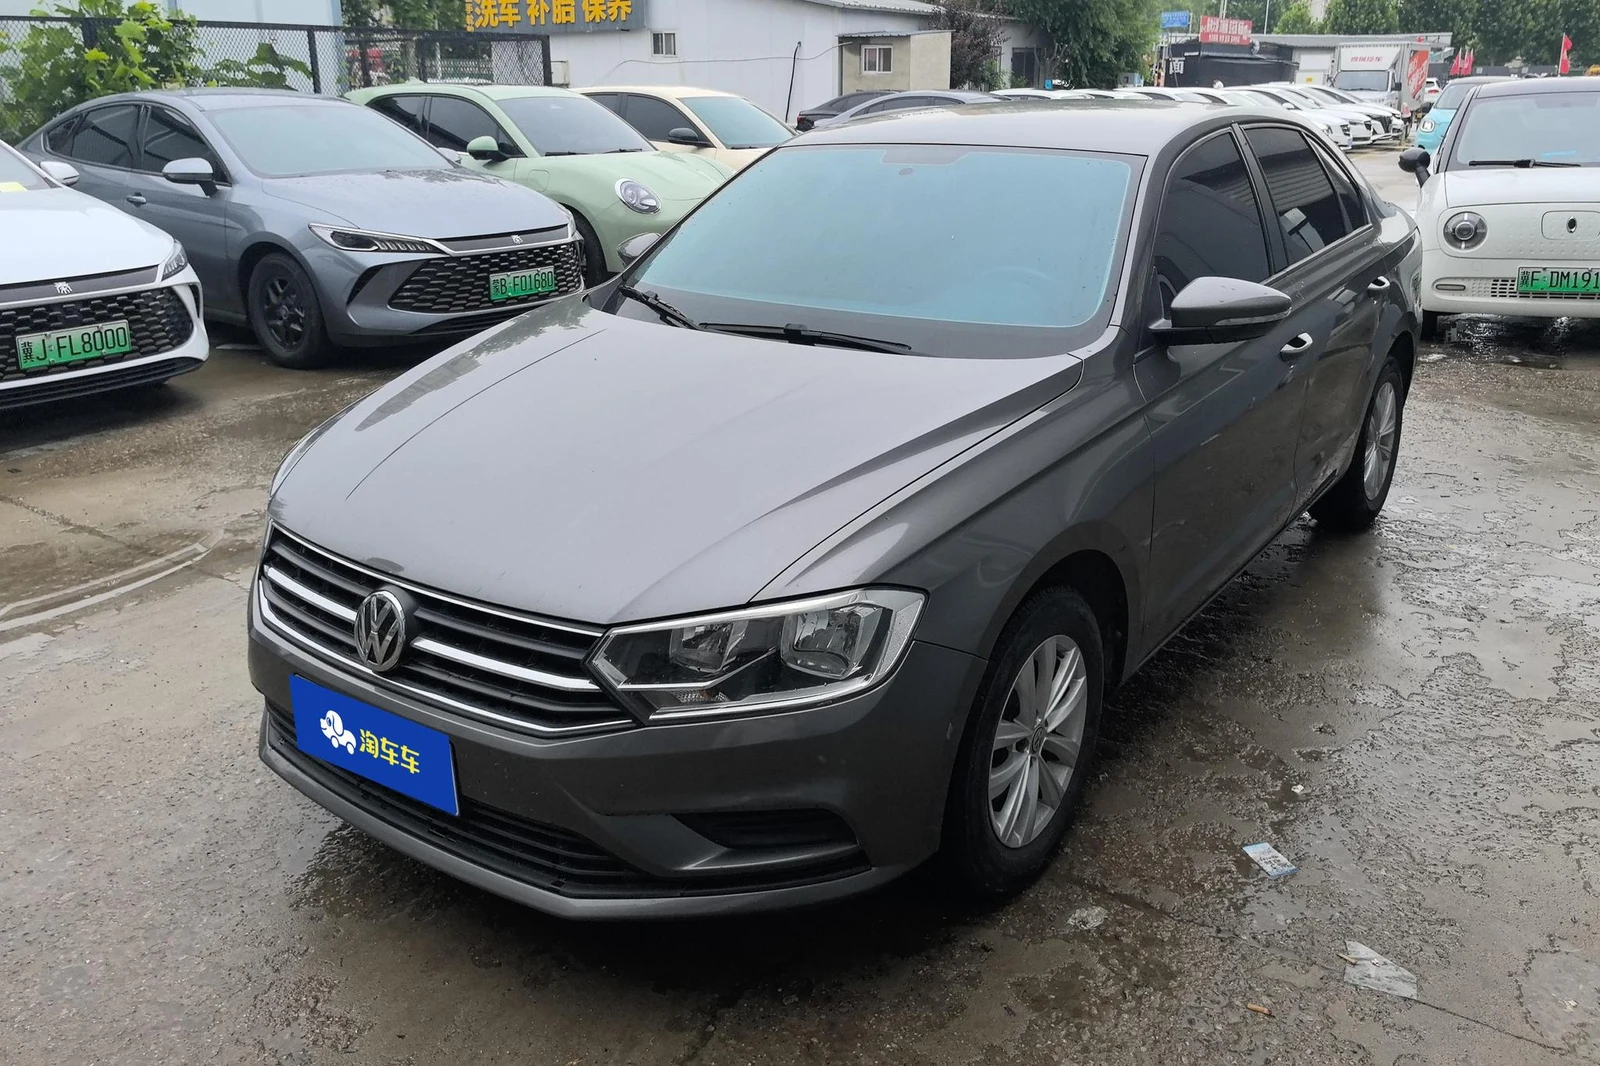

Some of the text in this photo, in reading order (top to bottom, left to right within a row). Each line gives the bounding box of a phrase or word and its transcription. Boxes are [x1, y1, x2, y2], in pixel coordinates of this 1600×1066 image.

[475, 0, 632, 28] 洗车 补胎 保养
